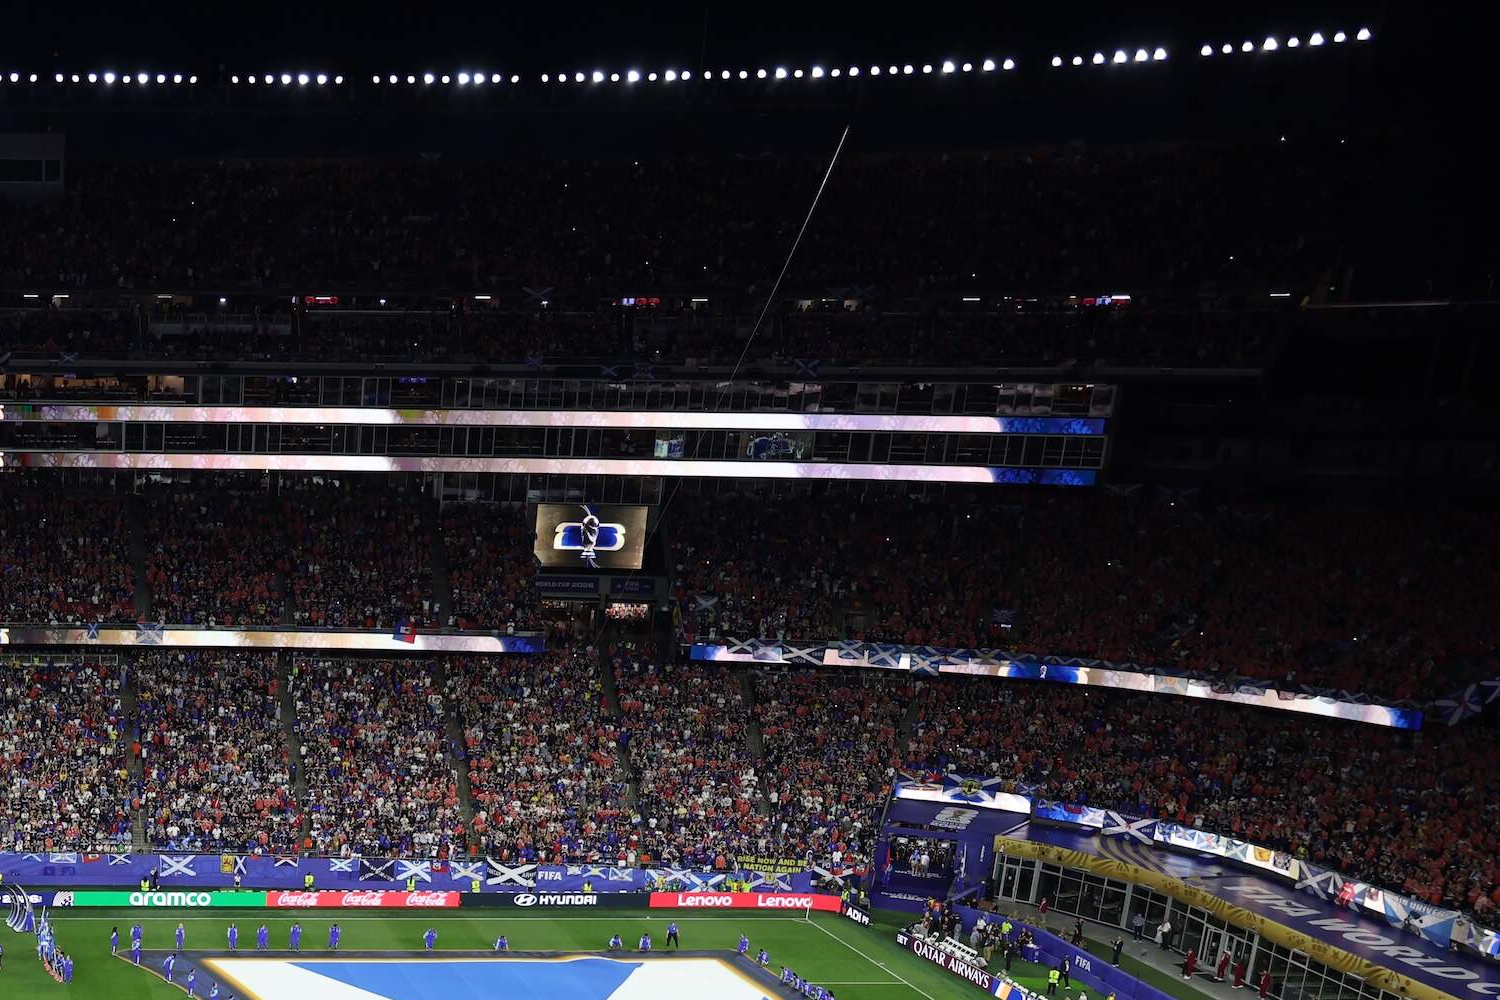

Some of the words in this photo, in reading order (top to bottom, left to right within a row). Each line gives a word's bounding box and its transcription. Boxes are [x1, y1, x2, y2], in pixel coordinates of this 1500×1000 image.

[743, 863, 774, 872] NATION
[775, 865, 802, 873] AGAIN
[758, 857, 776, 865] NOW
[538, 871, 562, 881] FIFA
[129, 892, 212, 906] aramco
[539, 894, 597, 905] HYUNDAI
[677, 894, 732, 907] Lenovo
[757, 894, 812, 908] Lenovo
[846, 907, 862, 923] ADI
[1224, 886, 1321, 917] FIFA
[1307, 918, 1481, 980] WORLD
[913, 940, 946, 967] QATAR
[948, 957, 990, 988] AIRWAYS
[1075, 955, 1092, 973] FIFA
